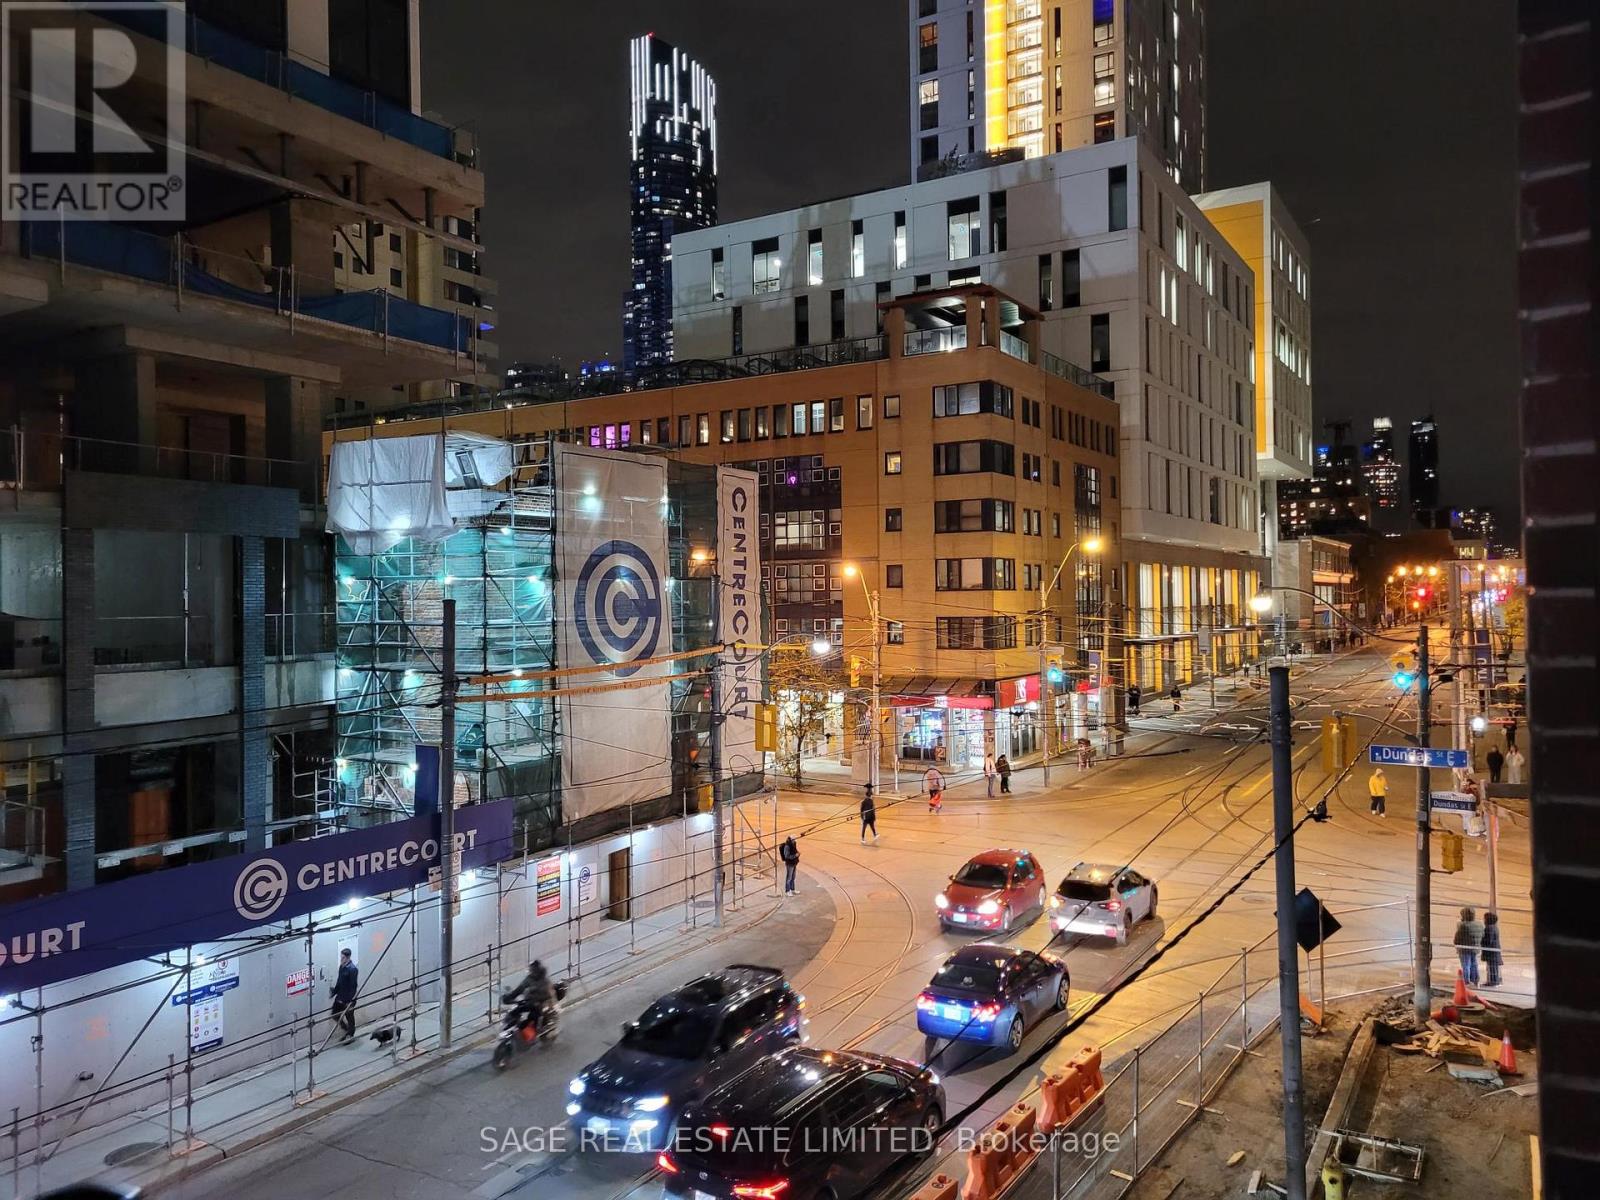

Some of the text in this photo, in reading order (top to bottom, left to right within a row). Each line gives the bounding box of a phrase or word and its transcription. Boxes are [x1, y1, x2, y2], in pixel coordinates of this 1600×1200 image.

[1382, 748, 1432, 762] Dundas
[1433, 800, 1458, 809] Dundas
[297, 829, 478, 891] CENTRECORT
[0, 920, 86, 967] URT
